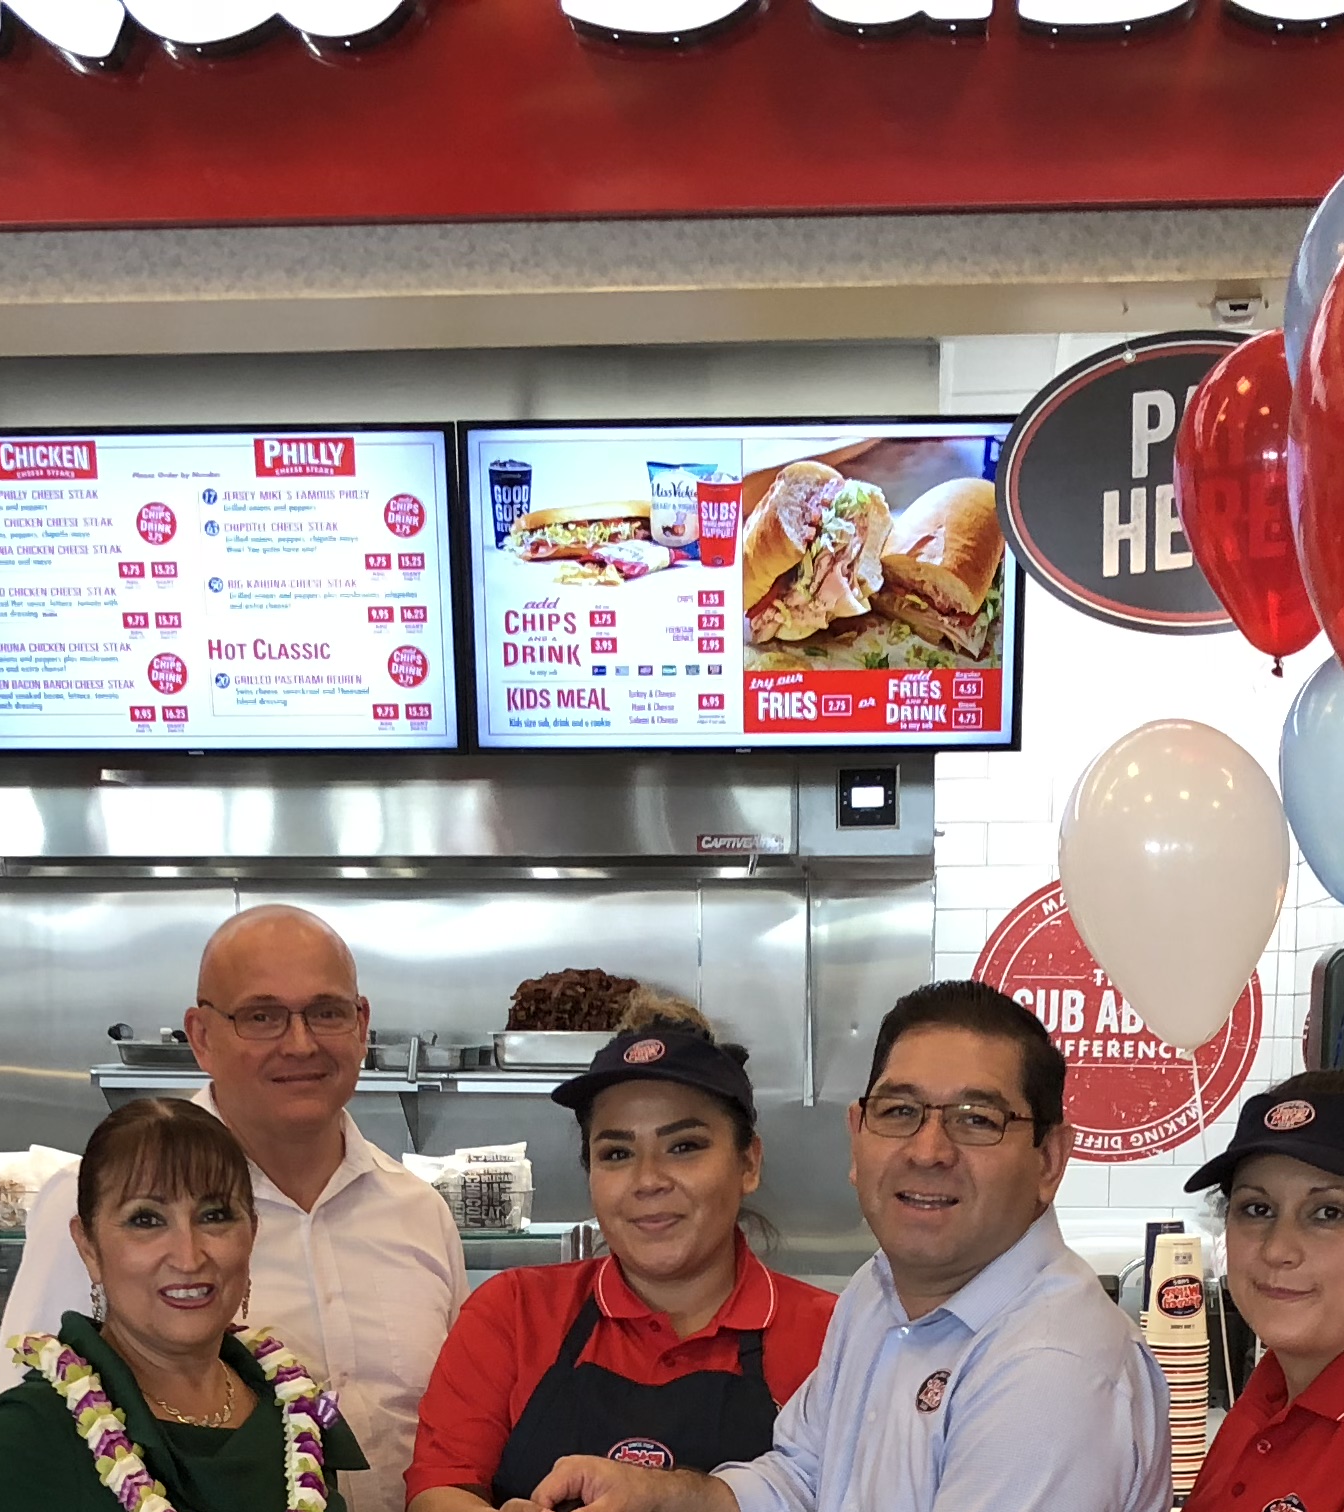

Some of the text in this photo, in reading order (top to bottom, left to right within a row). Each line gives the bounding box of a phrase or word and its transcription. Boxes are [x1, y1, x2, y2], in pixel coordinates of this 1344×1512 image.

[0, 443, 90, 471] CHICKEN
[263, 439, 345, 468] PHILLY
[494, 486, 529, 504] GOOD
[700, 501, 737, 521] SUBS
[504, 610, 577, 636] CHIPS
[594, 614, 612, 625] 3.75
[208, 638, 331, 661] HOT CLASSIC
[503, 642, 582, 668] DRINK
[749, 677, 775, 690] try
[888, 678, 942, 700] FRIES
[506, 687, 611, 712] KIDS MEAL
[757, 691, 818, 721] FRIES
[886, 703, 947, 725] DRINK
[1056, 1039, 1188, 1060] IFFERENCE
